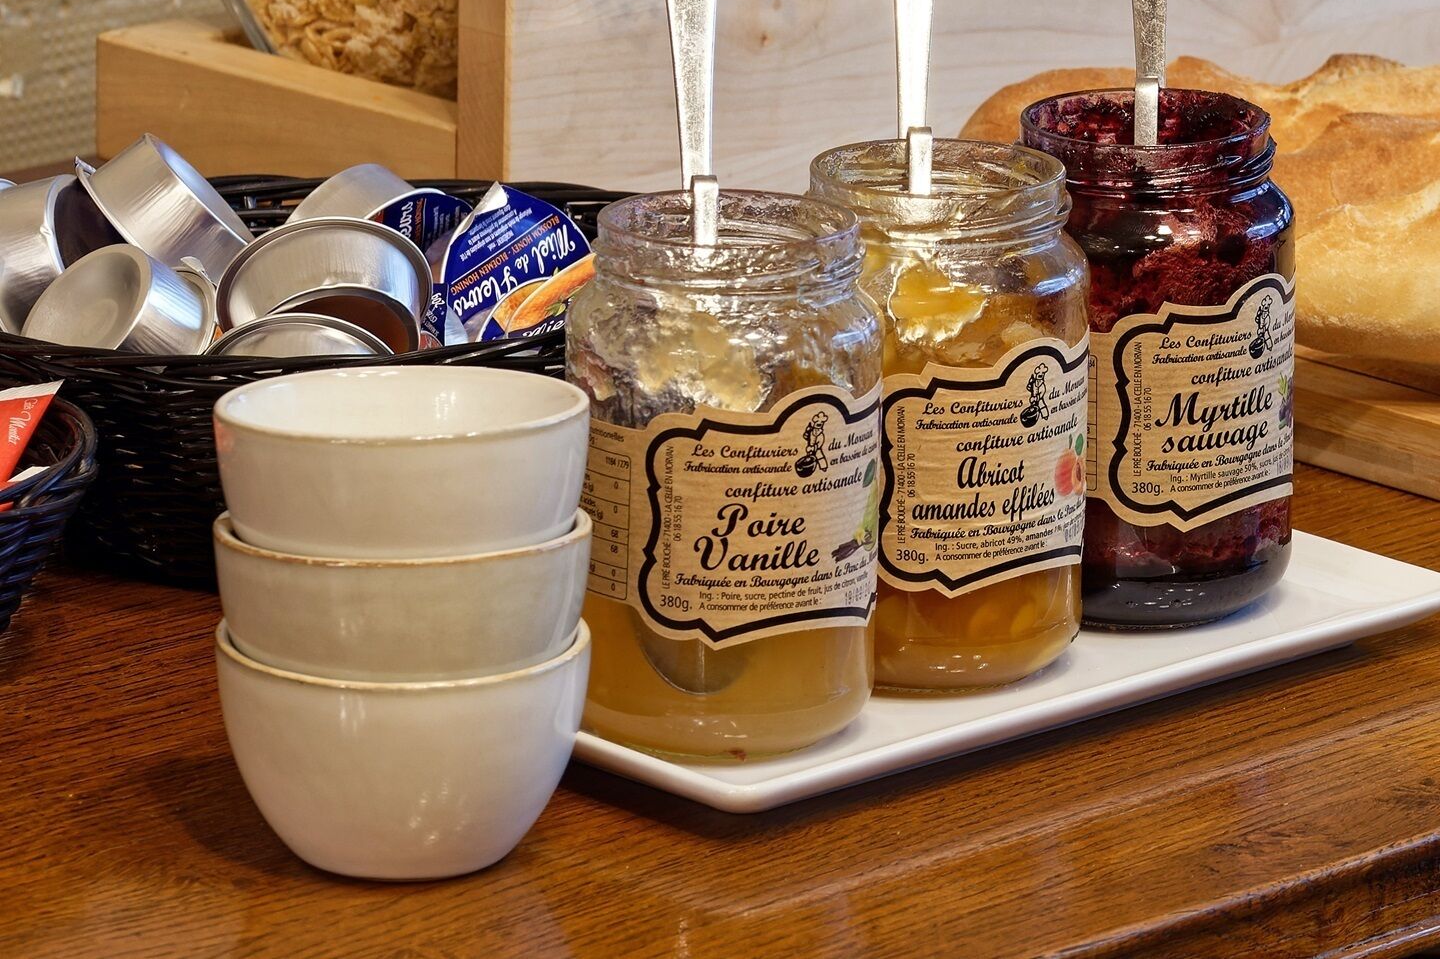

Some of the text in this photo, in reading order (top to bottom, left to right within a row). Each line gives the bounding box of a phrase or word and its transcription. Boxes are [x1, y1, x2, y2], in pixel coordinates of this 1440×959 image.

[400, 201, 414, 239] eurs
[533, 214, 561, 235] BLOSSOM
[511, 232, 533, 254] HONEY
[532, 224, 576, 274] Miel
[480, 251, 509, 277] BLOEMEN
[514, 256, 529, 274] de
[450, 270, 479, 296] HONING
[453, 266, 518, 317] Fleurs
[1159, 336, 1181, 349] Les
[1186, 331, 1252, 350] Confituriers
[1134, 342, 1142, 369] MORVAN
[1152, 354, 1204, 364] Fabrication
[1206, 346, 1248, 362] artisanale
[1191, 366, 1252, 387] confiture
[922, 402, 945, 414] Les
[950, 399, 1023, 417] Confituriers
[1048, 386, 1060, 400] du
[1154, 385, 1273, 432] Myrtille
[897, 406, 906, 434] MORVAN
[915, 420, 970, 430] Fabrication
[972, 413, 1018, 428] artisanale
[956, 412, 1078, 455] confiture artisanale
[1133, 432, 1142, 457] BOUCHÉ
[1161, 420, 1268, 454] sauvage
[666, 445, 674, 475] MORVAN
[691, 444, 715, 458] Les
[720, 445, 799, 462] Confituriers
[828, 438, 842, 452] du
[898, 444, 906, 462] CELLE
[1146, 458, 1200, 473] Fabriquée
[1214, 449, 1262, 466] Bourgogne
[1262, 444, 1278, 455] dans
[684, 460, 740, 474] Fabrication
[742, 462, 792, 474] artisanale
[957, 456, 1024, 489] Abricot
[1133, 458, 1142, 468] PRÉ
[725, 467, 862, 503] confiture artisanale
[898, 474, 906, 494] 71400
[1190, 471, 1217, 483] Myrtille
[1217, 467, 1244, 478] sauvage
[665, 486, 674, 504] CELLE
[1132, 482, 1164, 496] 380g.
[1177, 482, 1214, 492] consommer
[896, 498, 906, 524] BOUCHÉ
[912, 492, 996, 520] amandes
[1002, 483, 1055, 522] effilées
[664, 517, 672, 537] 71400
[712, 503, 806, 538] Poire
[896, 524, 906, 536] PRÉ
[910, 528, 966, 542] Fabriquée
[968, 528, 980, 537] en
[982, 520, 1036, 536] Bourgogne
[1037, 514, 1056, 526] dans
[1057, 508, 1064, 520] le
[980, 538, 1006, 549] abricot
[1025, 528, 1054, 541] amandes
[662, 542, 672, 568] BOUCHÉ
[693, 535, 820, 571] Vanille
[896, 549, 929, 564] 380g.
[942, 552, 982, 561] consommer
[992, 546, 1024, 559] préférence
[662, 569, 671, 581] PRÉ
[662, 581, 670, 589] LE
[674, 573, 732, 590] Fabriquée
[734, 580, 748, 588] en
[750, 576, 809, 590] Bourgogne
[811, 570, 832, 582] dans
[834, 565, 842, 578] le
[660, 595, 692, 612] 380g.
[706, 602, 748, 612] consommer
[760, 600, 793, 612] préférence
[768, 590, 796, 602] pectine
[796, 588, 806, 596] de
